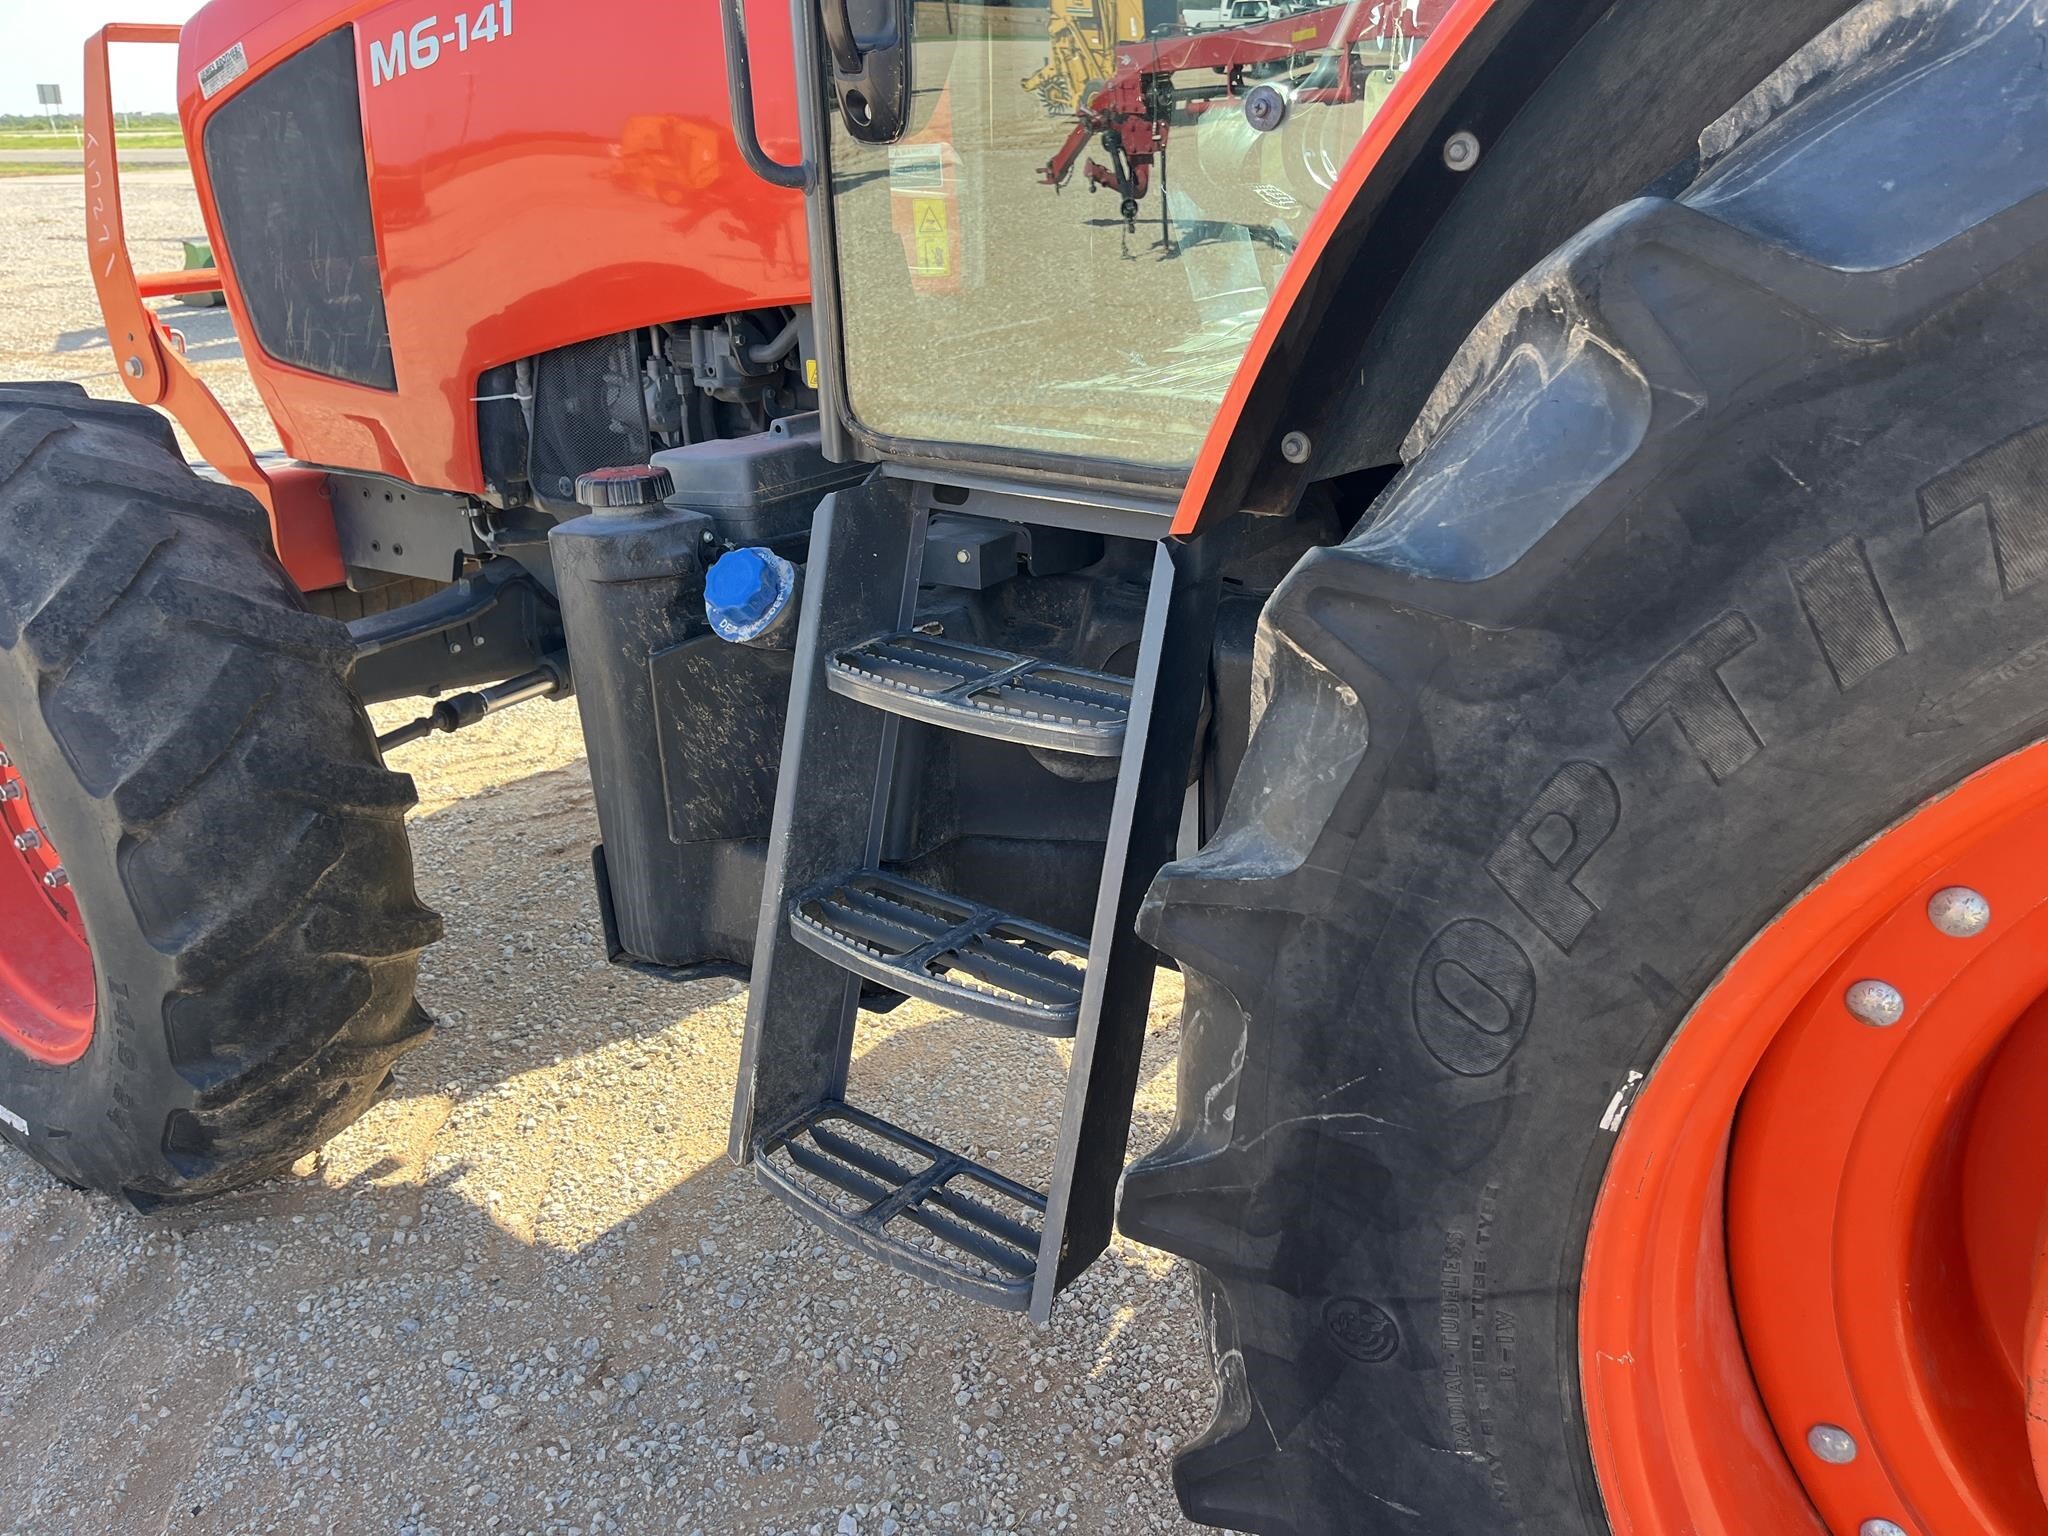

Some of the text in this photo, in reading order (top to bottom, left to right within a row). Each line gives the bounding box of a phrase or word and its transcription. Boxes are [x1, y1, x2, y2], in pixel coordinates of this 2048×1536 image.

[370, 0, 512, 88] M6-141
[1441, 1231, 1472, 1452] RADIAL TUBELESS
